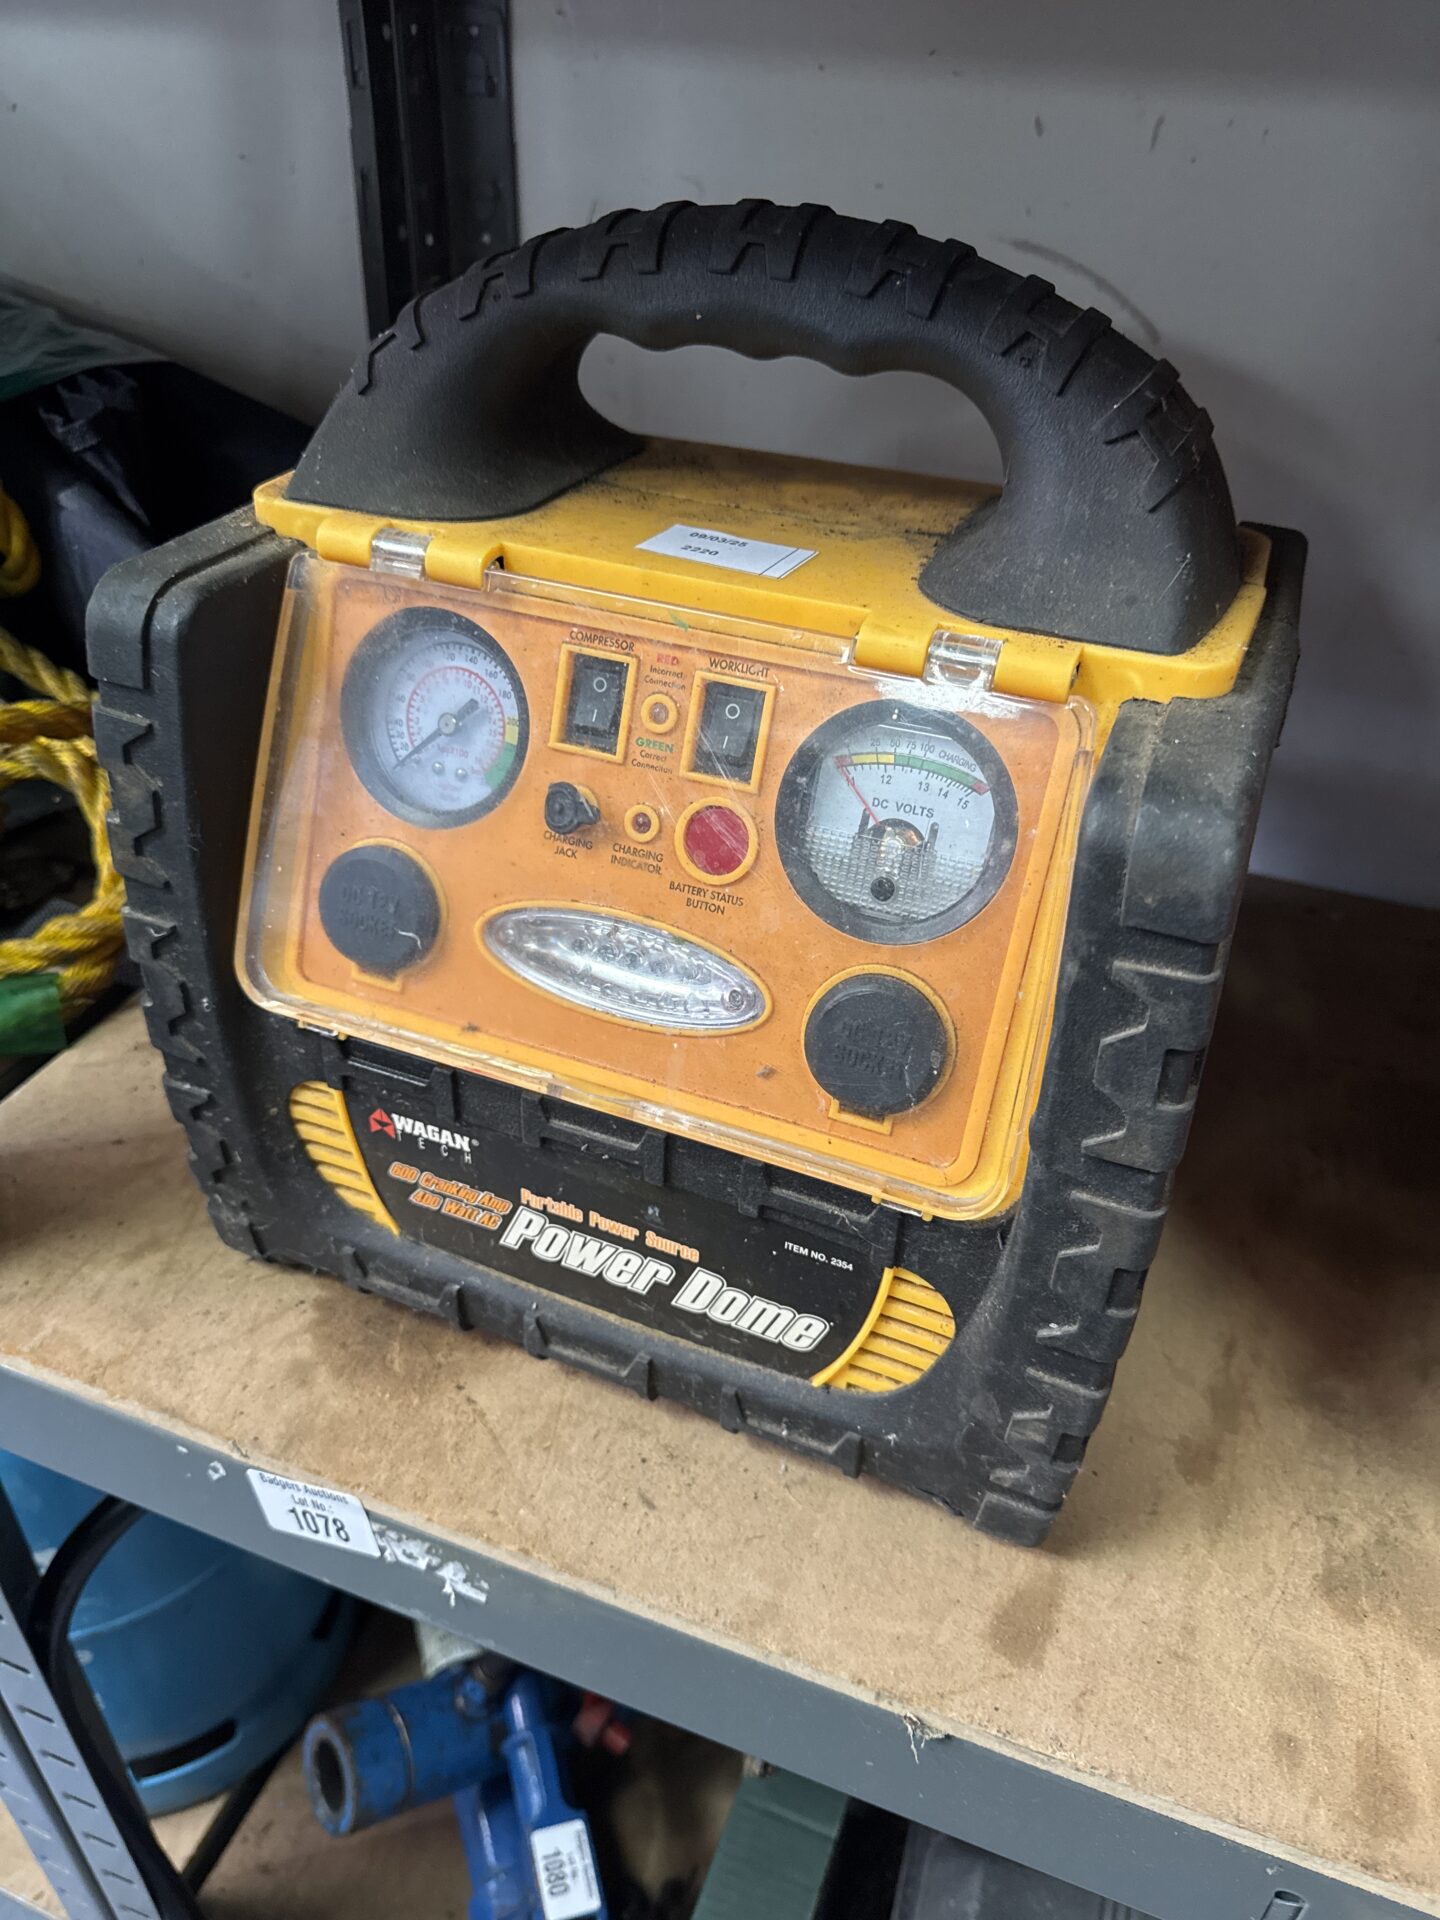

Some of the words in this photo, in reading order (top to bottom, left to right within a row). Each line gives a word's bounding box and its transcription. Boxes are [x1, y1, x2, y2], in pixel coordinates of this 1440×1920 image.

[680, 544, 720, 557] 2220
[569, 630, 635, 652] COMPRESSOR
[465, 654, 479, 665] 140
[656, 653, 680, 667] RED
[708, 656, 770, 678] WORKLIGHT
[484, 668, 499, 680] 160
[650, 665, 685, 678] Incorrect
[644, 675, 687, 690] Connection
[498, 690, 512, 700] 180
[635, 736, 674, 753] GREEN
[870, 738, 881, 748] 25
[890, 738, 900, 748] 50
[906, 740, 917, 751] 75
[920, 743, 936, 754] 100
[639, 749, 667, 763] Correct
[938, 750, 977, 773] CHARGING
[631, 758, 673, 775] Connection
[880, 774, 893, 785] 12
[917, 780, 930, 792] 13
[937, 787, 950, 800] 14
[871, 797, 889, 810] DC
[895, 801, 935, 819] VOLTS
[956, 797, 970, 810] 15
[543, 830, 593, 850] CHARGING
[554, 847, 578, 859] JACK
[612, 842, 664, 863] CHARGING
[610, 855, 662, 875] INDICATOR
[669, 880, 708, 898] BATTERY
[710, 889, 744, 906] STATUS
[686, 897, 726, 915] BUTTON
[391, 1112, 471, 1152] WAGAN
[396, 1129, 472, 1164] TECH
[419, 1171, 479, 1204] Cranking
[477, 1191, 513, 1215] Amp
[408, 1188, 443, 1210] 400
[441, 1198, 479, 1223] Watt
[477, 1211, 503, 1231] AC
[520, 1187, 584, 1223] Portable
[588, 1211, 640, 1241] Power
[645, 1229, 700, 1263] Source
[784, 1240, 809, 1258] ITEM
[810, 1248, 829, 1264] NO.
[830, 1255, 854, 1272] 2354
[499, 1205, 677, 1295] Power
[671, 1266, 831, 1351] Dome
[259, 1472, 302, 1492] Badgers
[304, 1484, 349, 1504] Auctions
[291, 1494, 309, 1507] Lot
[288, 1507, 350, 1542] 1078
[542, 1846, 570, 1897] 1080
